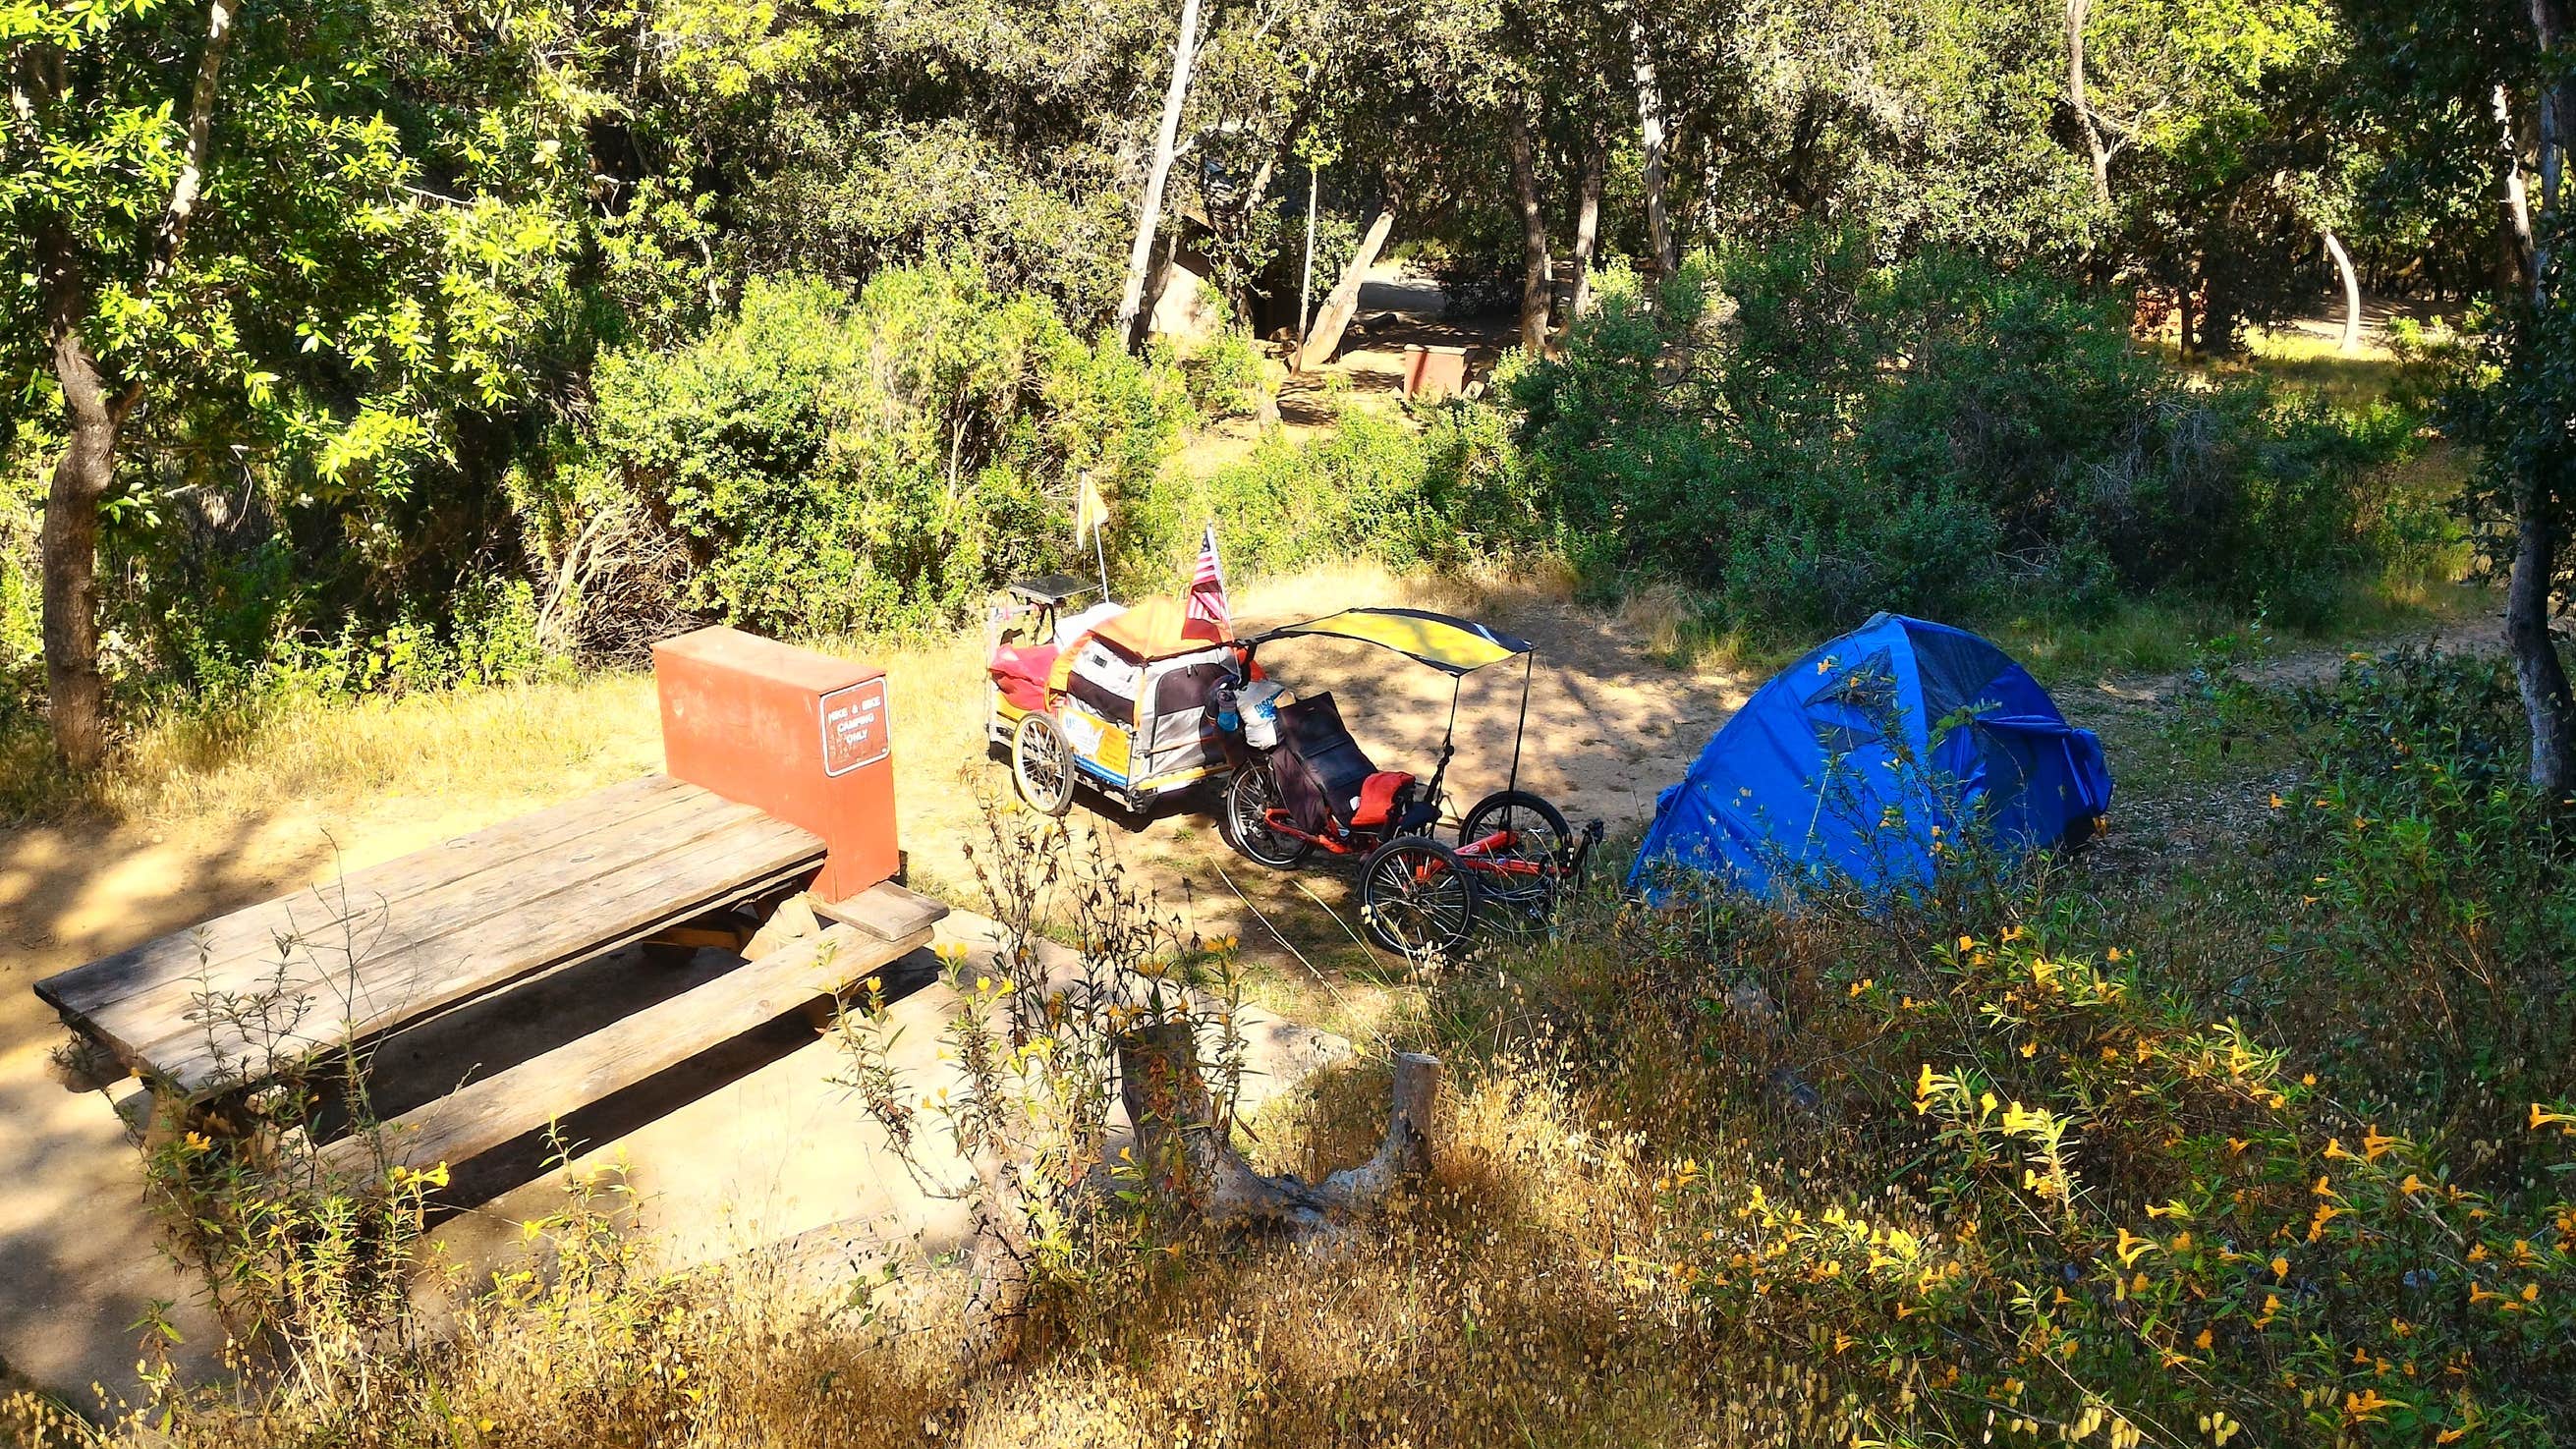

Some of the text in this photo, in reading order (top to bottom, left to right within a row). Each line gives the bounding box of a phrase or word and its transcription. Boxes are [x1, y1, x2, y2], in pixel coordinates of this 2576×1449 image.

[827, 707, 849, 725] HIKE
[862, 696, 881, 711] BIKE
[838, 712, 875, 734] CAMPING
[846, 728, 868, 744] ONLY
